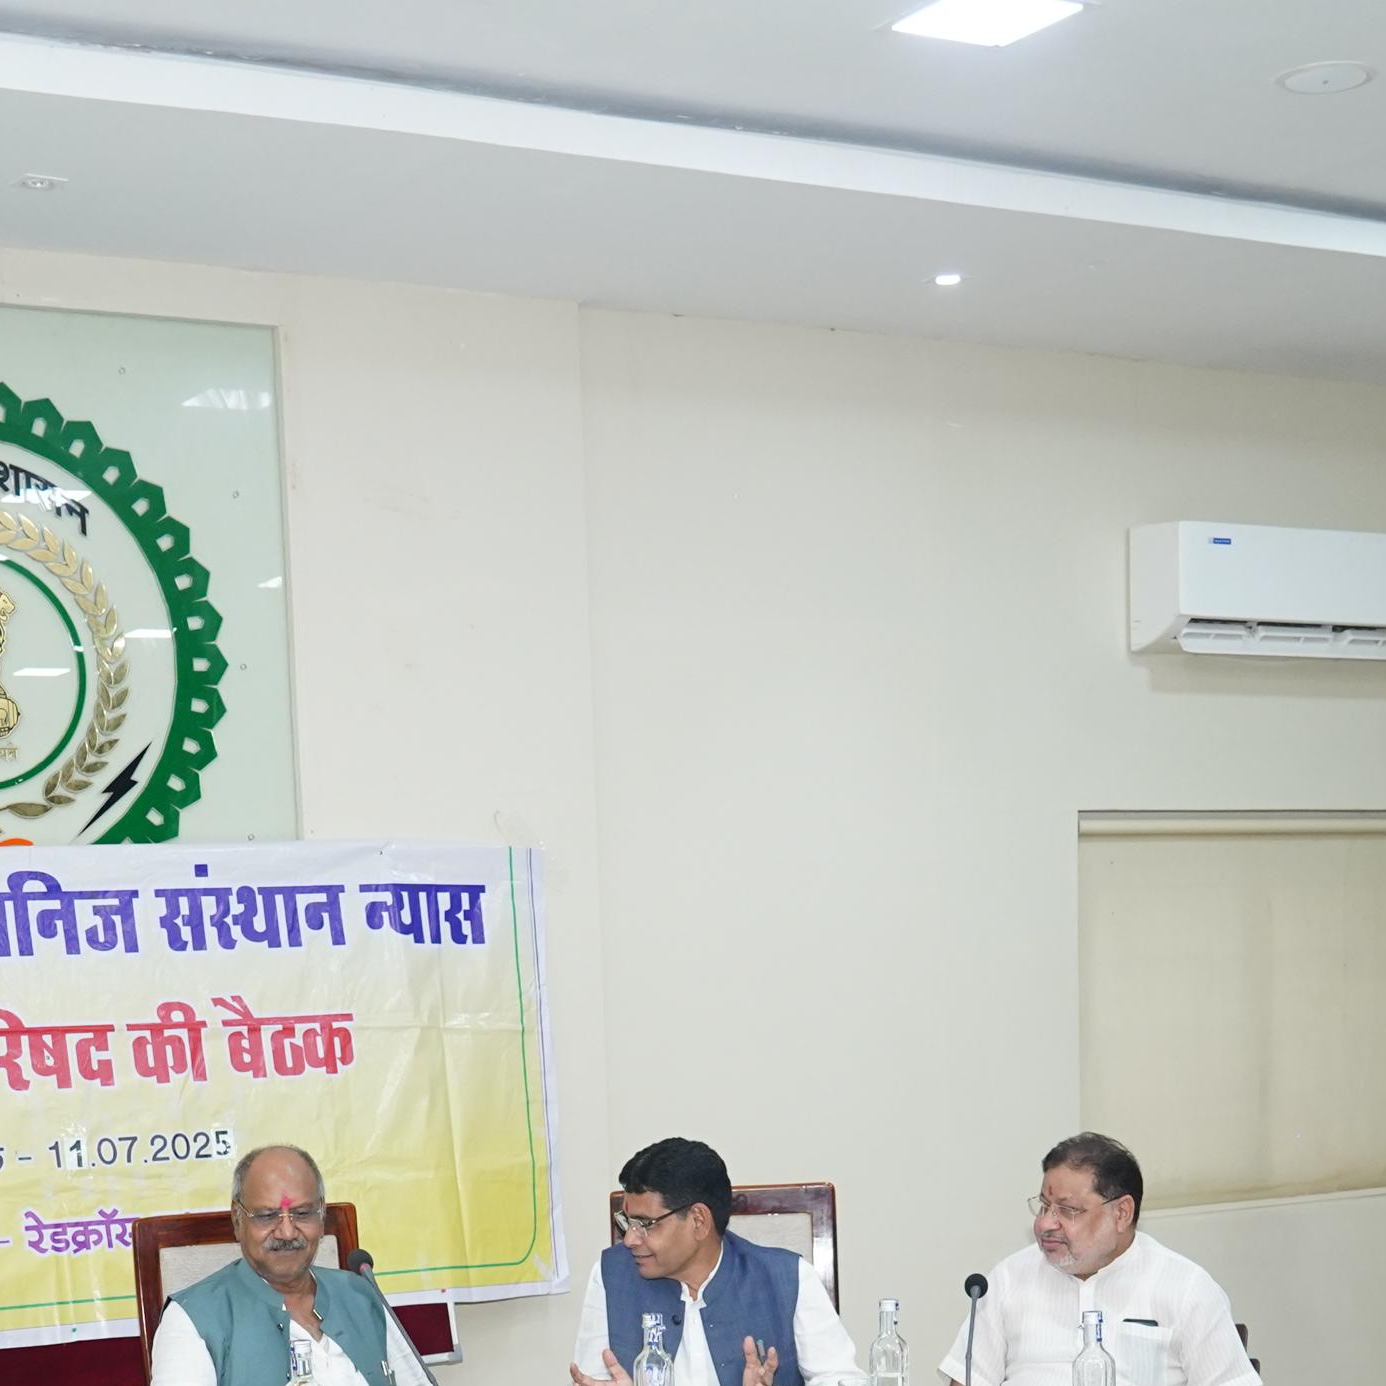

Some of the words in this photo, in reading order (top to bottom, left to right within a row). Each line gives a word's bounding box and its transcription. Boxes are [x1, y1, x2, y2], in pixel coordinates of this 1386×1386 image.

[154, 863, 345, 952] संस्थान
[358, 883, 486, 946] न्यास
[126, 1001, 207, 1084] की
[211, 994, 355, 1079] बैठक
[48, 1129, 232, 1170] 11.07.2025
